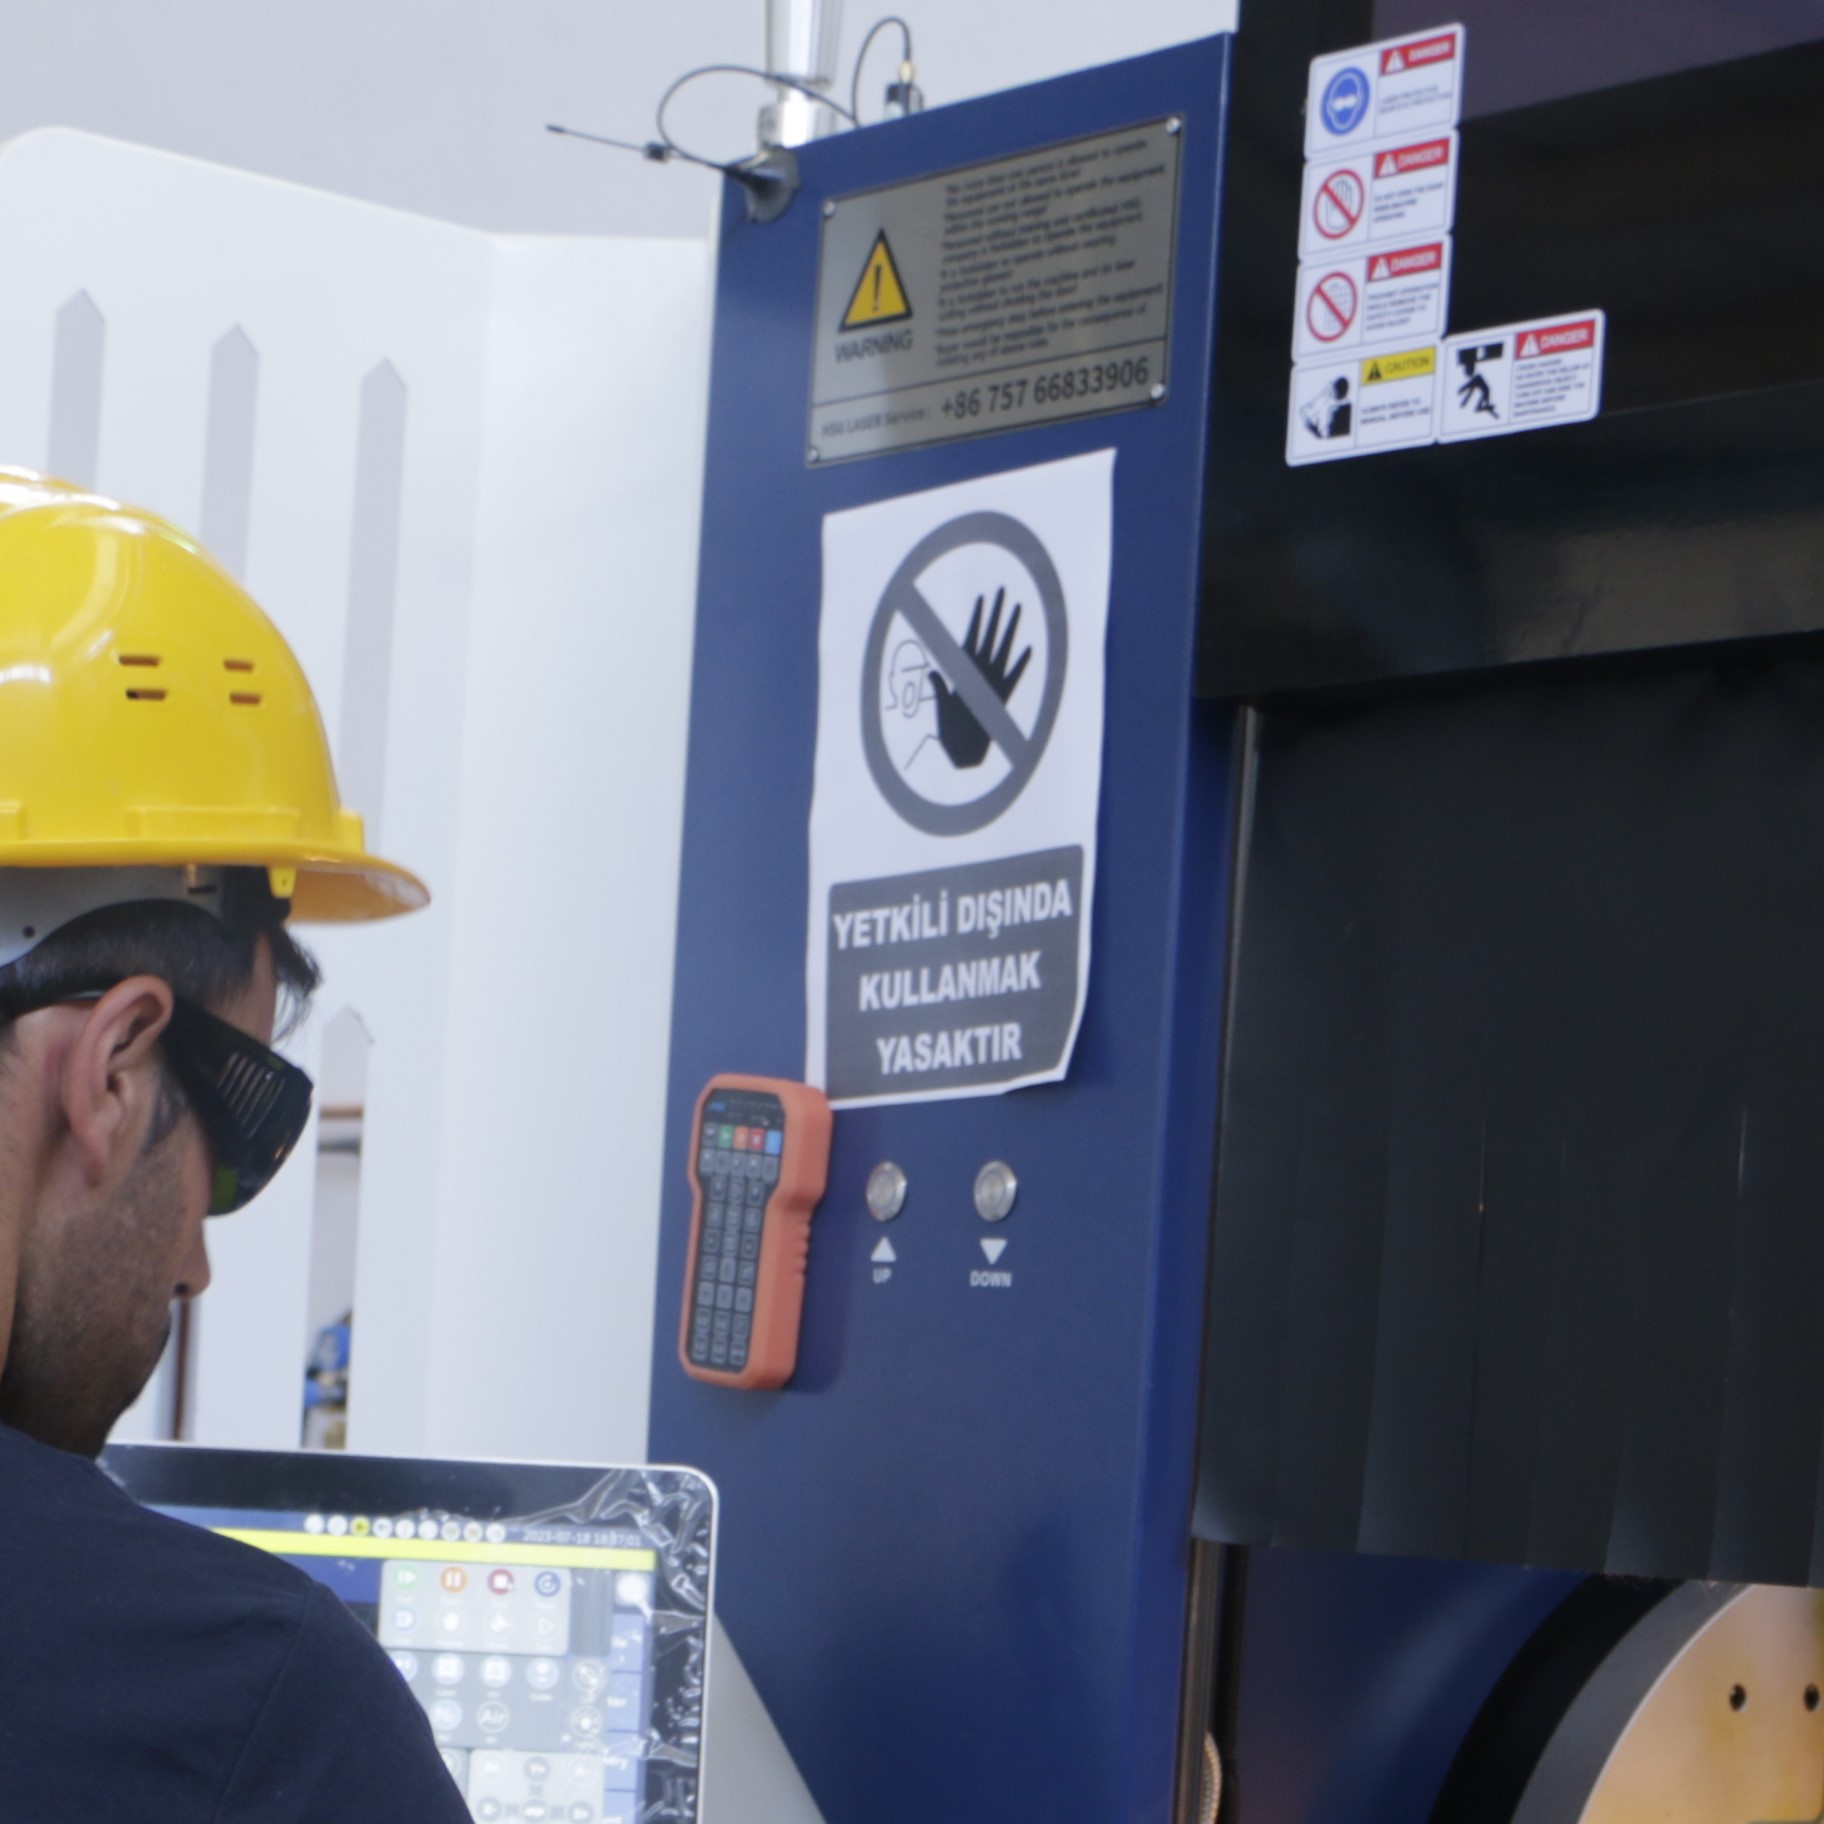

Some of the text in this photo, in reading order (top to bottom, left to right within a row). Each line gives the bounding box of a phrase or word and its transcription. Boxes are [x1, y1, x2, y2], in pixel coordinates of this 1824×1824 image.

[1408, 40, 1451, 62] DANGER
[1396, 145, 1444, 168] DANGER
[1391, 249, 1437, 272] DANGER
[835, 328, 913, 362] WARNING
[1540, 328, 1589, 349] DANGER
[1384, 355, 1430, 374] CAUTION
[942, 386, 980, 419] +86
[988, 380, 1028, 412] 757
[1034, 357, 1149, 404] 66833906
[833, 879, 1073, 949] YETKİLİ DIŞINDA
[859, 951, 1042, 1012] KULLANMAK
[877, 1022, 1023, 1075] YASAKTIR
[873, 1268, 892, 1283] UP
[970, 1271, 1013, 1287] DOWN
